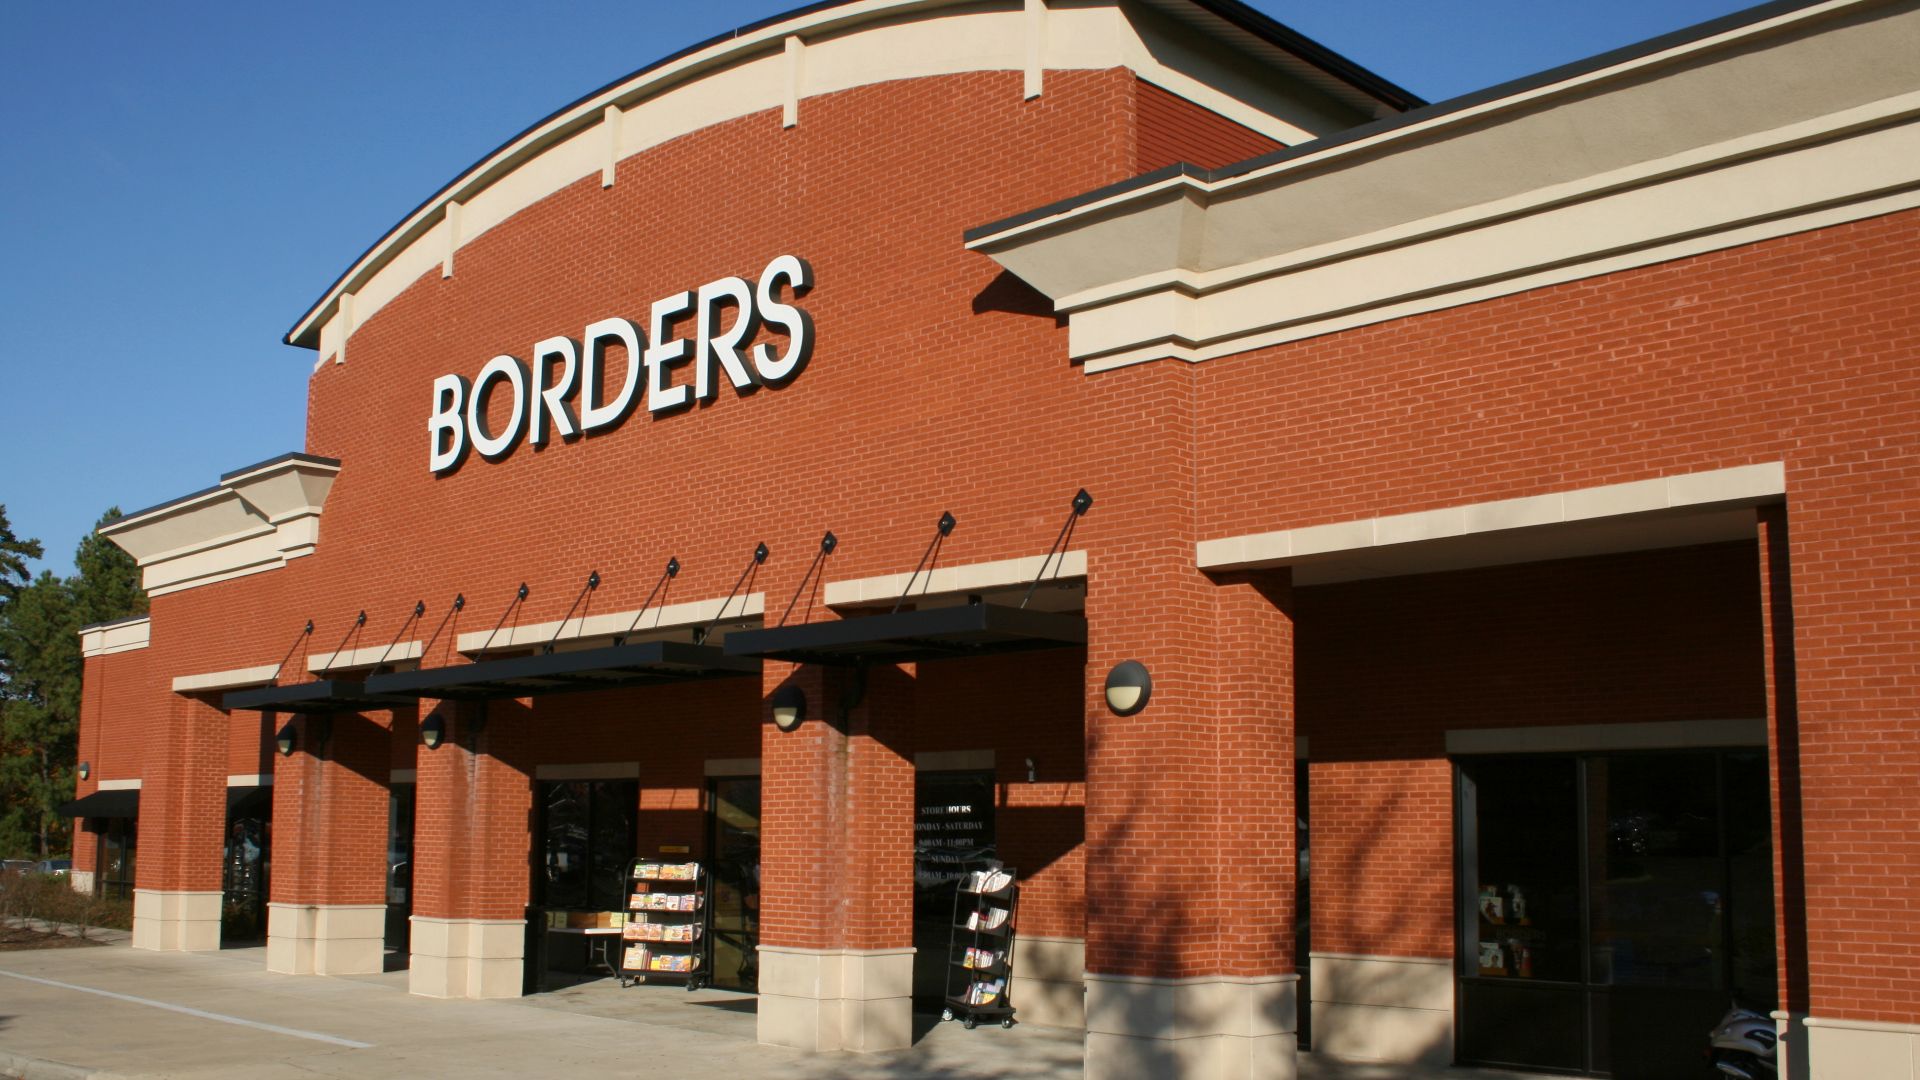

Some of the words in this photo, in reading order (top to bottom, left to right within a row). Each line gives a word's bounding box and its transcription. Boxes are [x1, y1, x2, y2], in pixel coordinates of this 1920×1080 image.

[428, 254, 806, 473] BORDERS
[920, 806, 945, 816] STORE
[945, 804, 972, 814] HOURS
[945, 821, 983, 831] SATURDAY
[930, 855, 960, 865] SUNDAY
